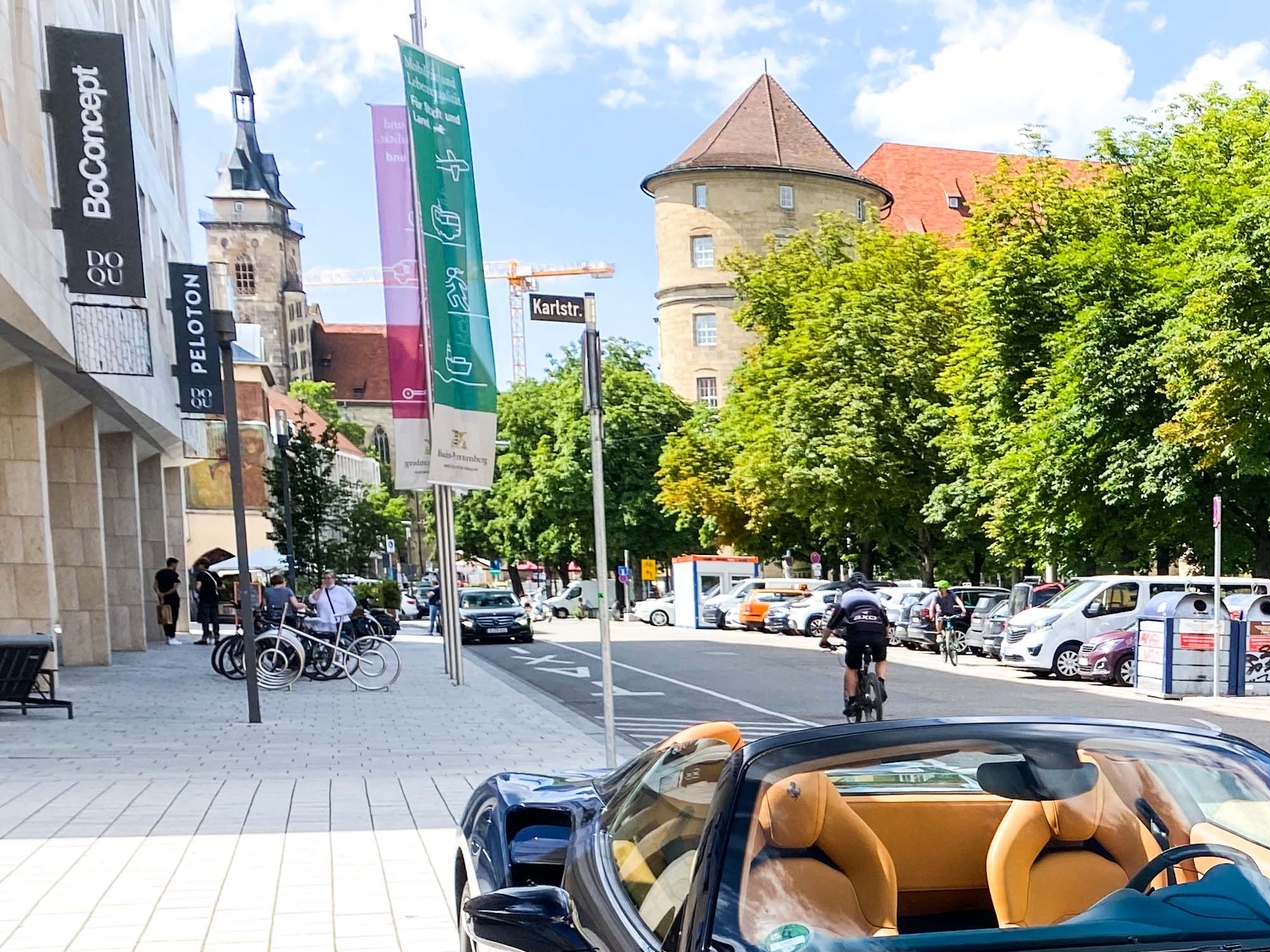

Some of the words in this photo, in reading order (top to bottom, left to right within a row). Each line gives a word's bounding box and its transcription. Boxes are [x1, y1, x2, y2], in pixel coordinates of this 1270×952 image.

[71, 64, 113, 220] BoConcept
[182, 273, 208, 374] PELOTON
[532, 297, 583, 317] Karlstr.
